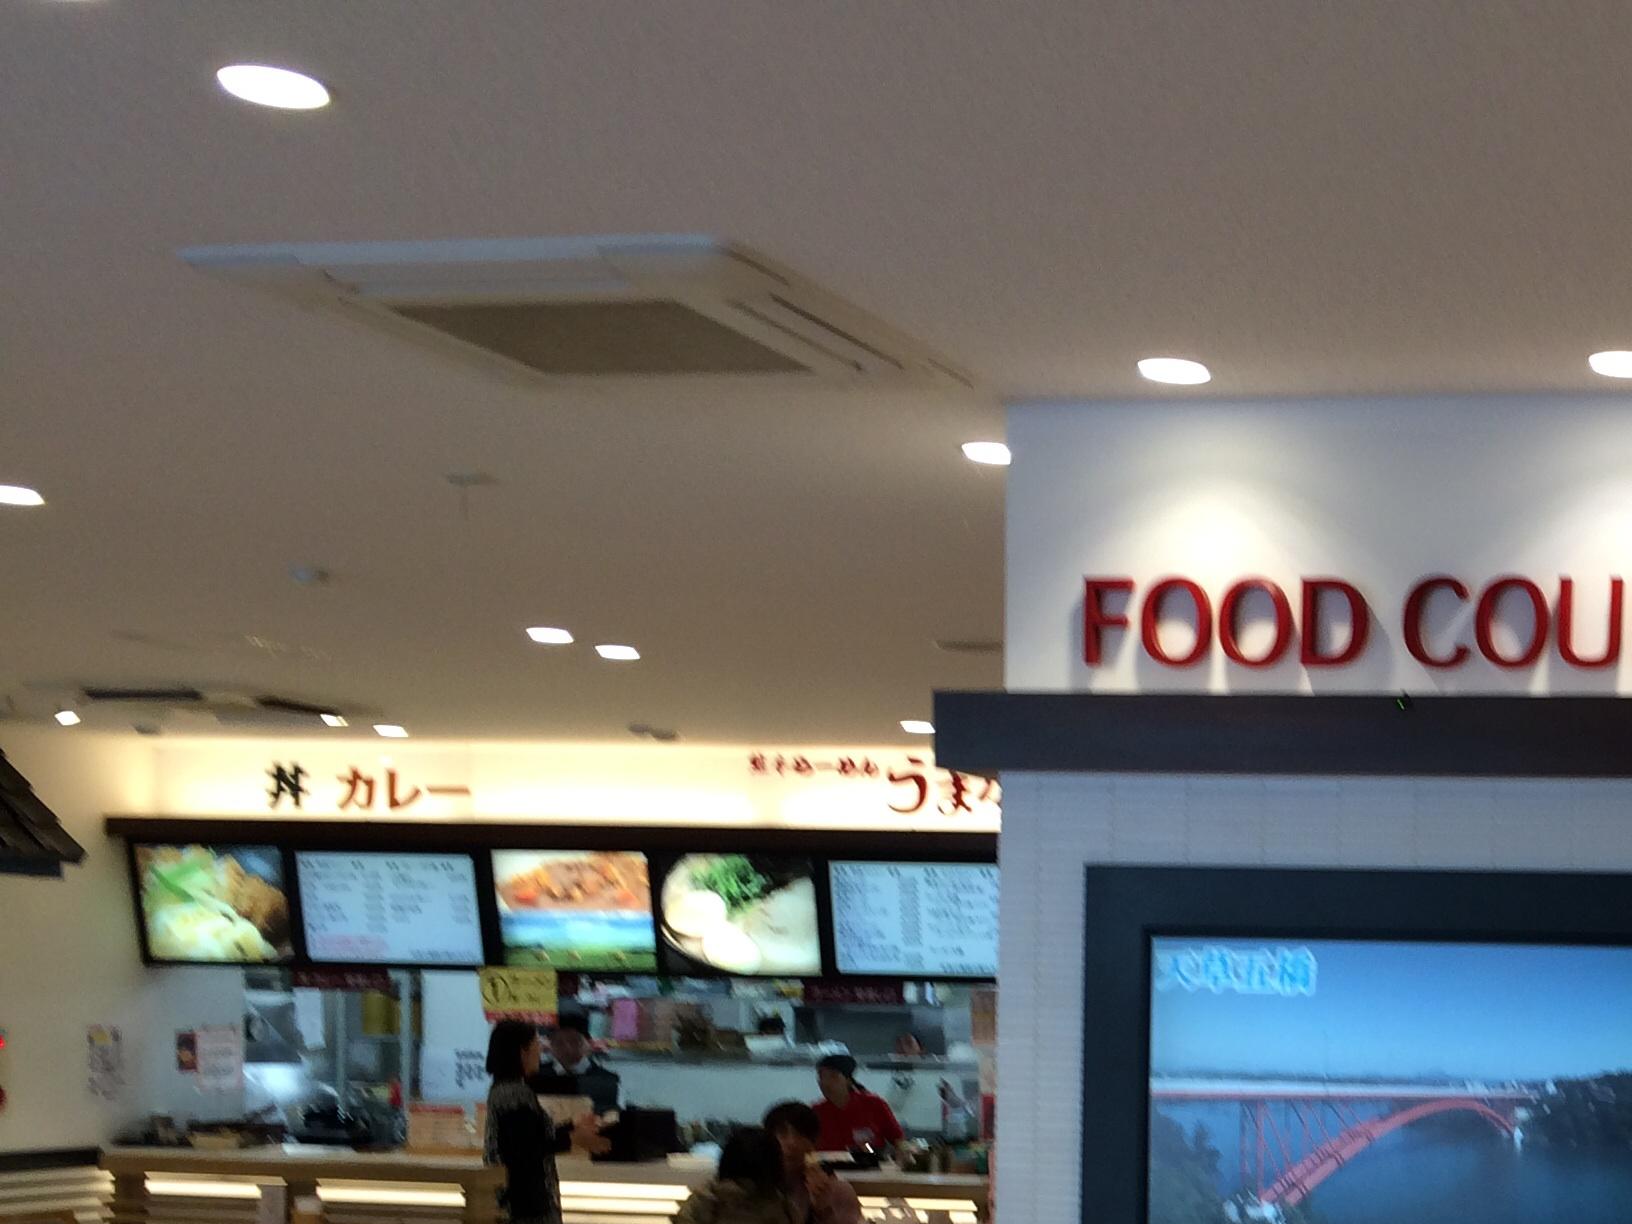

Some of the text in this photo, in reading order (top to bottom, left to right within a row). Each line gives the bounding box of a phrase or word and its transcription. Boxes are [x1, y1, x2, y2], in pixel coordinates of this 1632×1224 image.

[1082, 574, 1370, 669] FOOD
[336, 765, 471, 810] カレー
